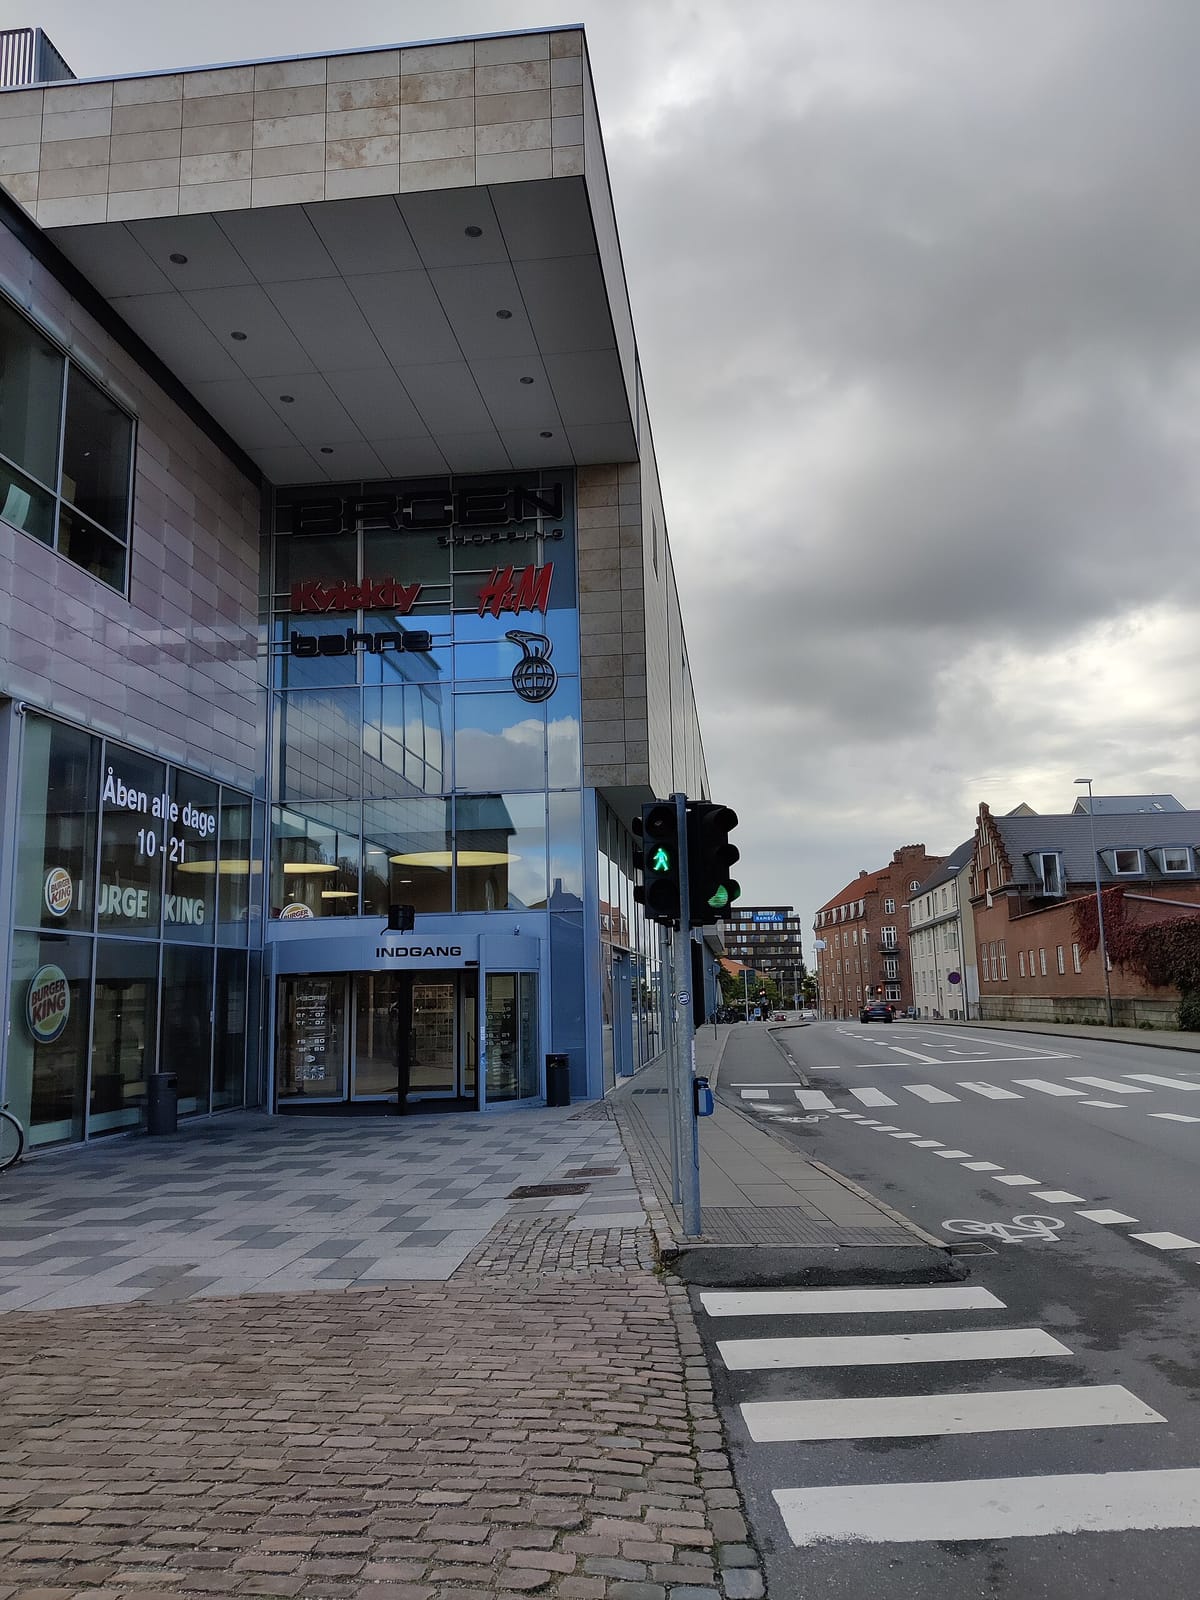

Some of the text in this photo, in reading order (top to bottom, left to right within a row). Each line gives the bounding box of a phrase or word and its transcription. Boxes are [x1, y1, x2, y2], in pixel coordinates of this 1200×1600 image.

[292, 482, 564, 538] BROEN
[437, 529, 564, 546] SHOPPING
[291, 577, 422, 613] Kvickly
[476, 561, 554, 620] H&M
[103, 766, 216, 837] Åben alle dage
[138, 828, 156, 857] 10
[169, 837, 185, 864] 21
[50, 879, 70, 893] BURGER
[51, 886, 71, 905] KING
[164, 894, 204, 925] KING
[375, 946, 462, 958] INDGANG
[32, 979, 65, 1007] BURGER
[32, 992, 66, 1027] KING
